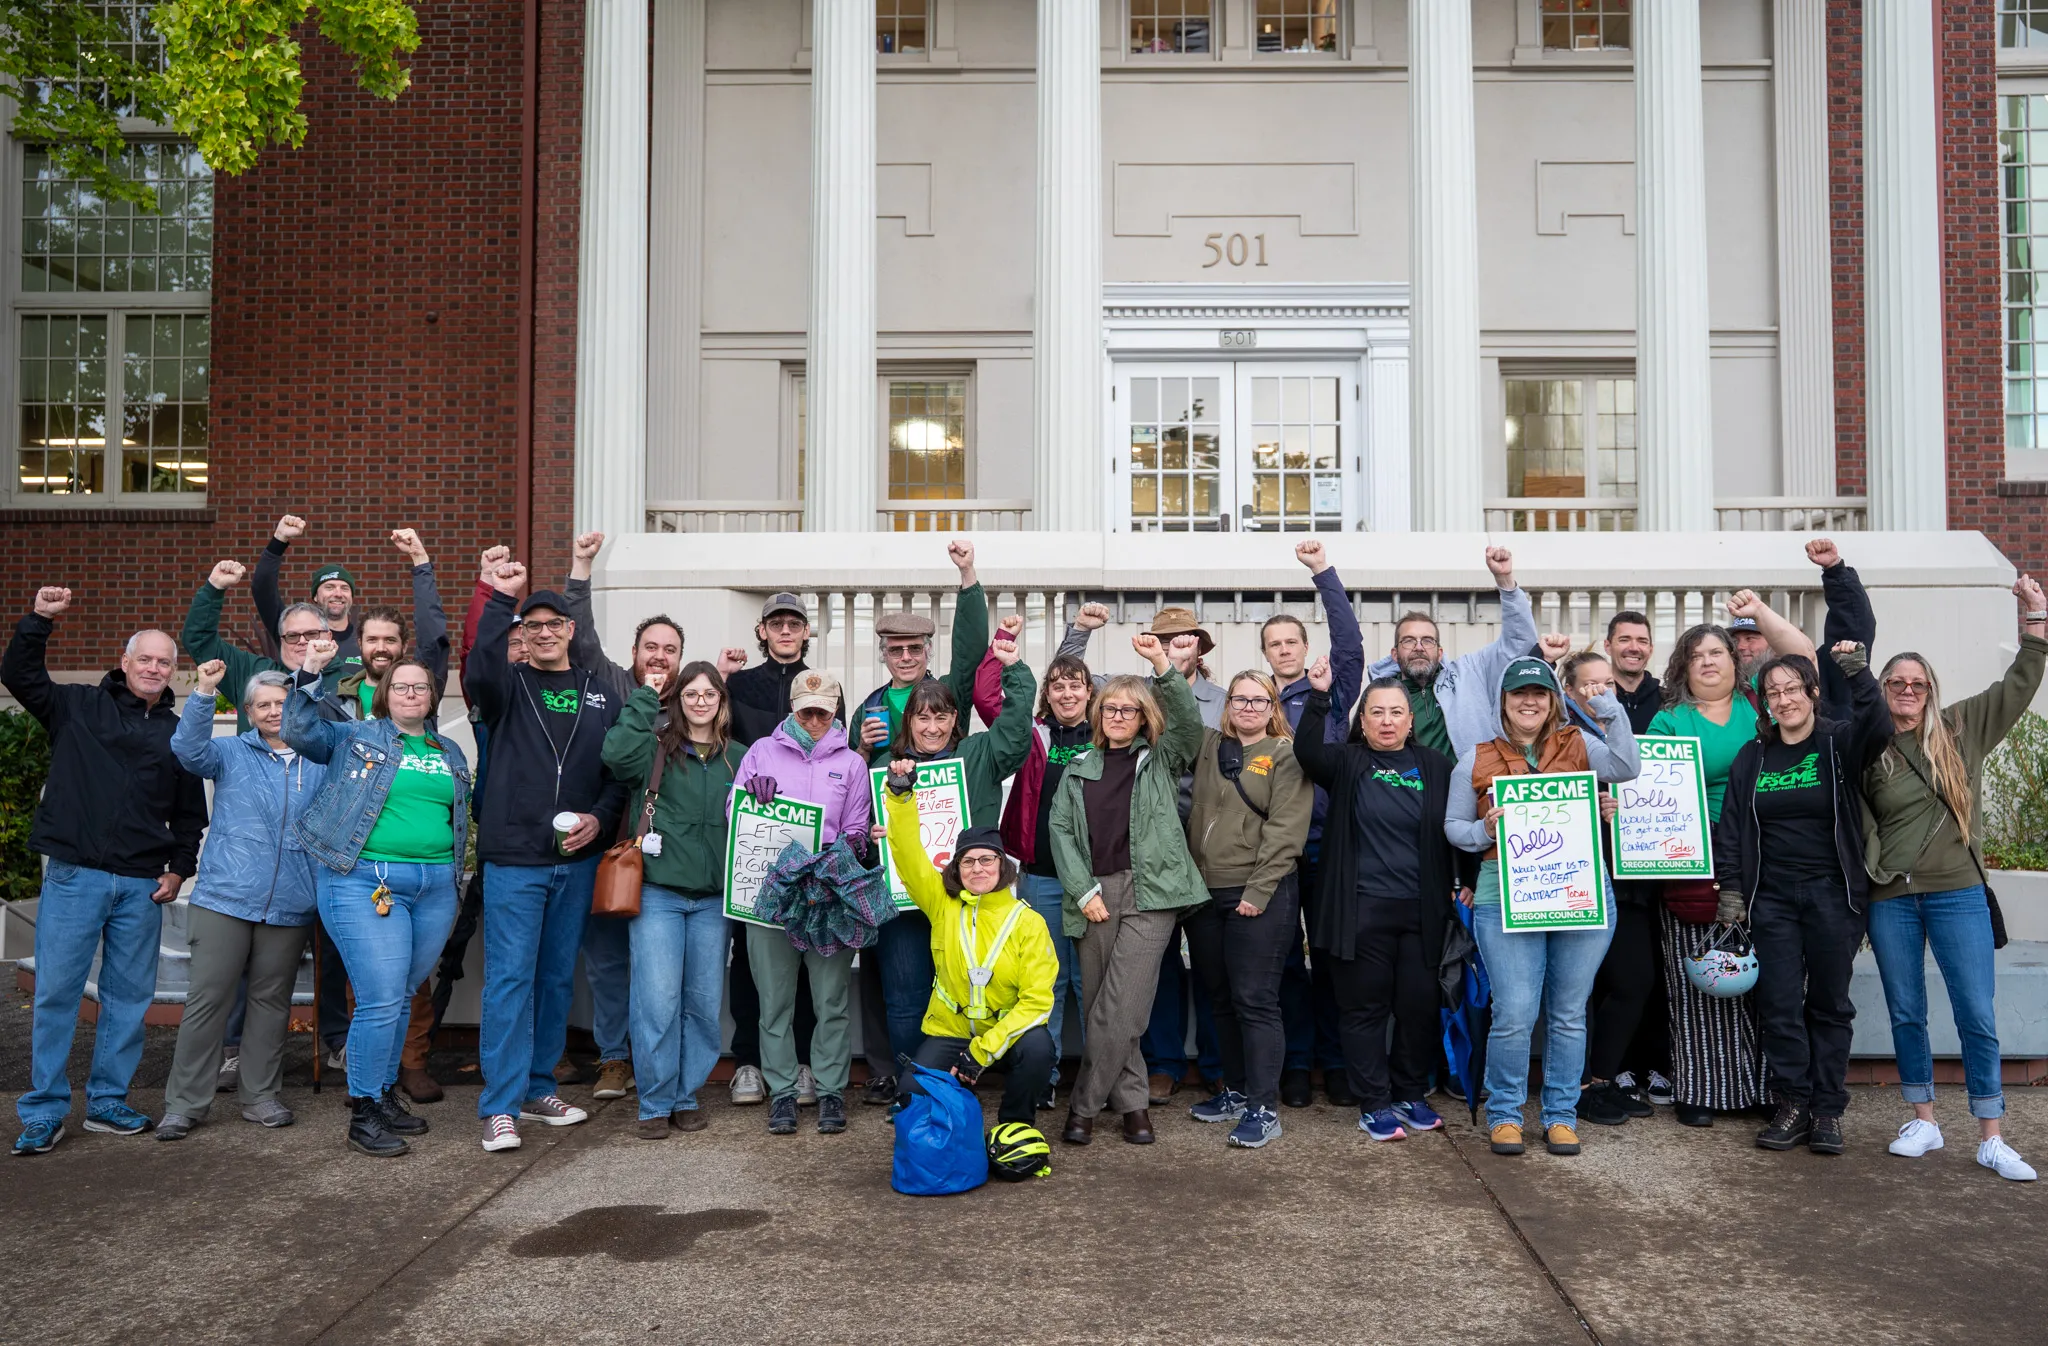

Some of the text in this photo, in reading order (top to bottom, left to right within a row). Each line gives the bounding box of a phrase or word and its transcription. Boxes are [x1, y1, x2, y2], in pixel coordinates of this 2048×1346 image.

[1202, 232, 1268, 268] 501
[1223, 332, 1252, 345] 501
[1638, 742, 1694, 760] SCME
[1636, 762, 1686, 787] -25
[1502, 780, 1589, 802] AFSCME
[1797, 780, 1822, 789] Happen
[1622, 788, 1681, 814] Dolly
[1514, 803, 1571, 827] 9-25
[1636, 827, 1652, 839] get
[1507, 828, 1563, 860] Dolly
[1660, 837, 1696, 858] Today
[734, 856, 742, 869] A
[1621, 860, 1705, 869] OREGON COUNCIL 75
[1540, 870, 1579, 885] GREAT
[1511, 910, 1598, 921] OREGON COUNCIL 75
